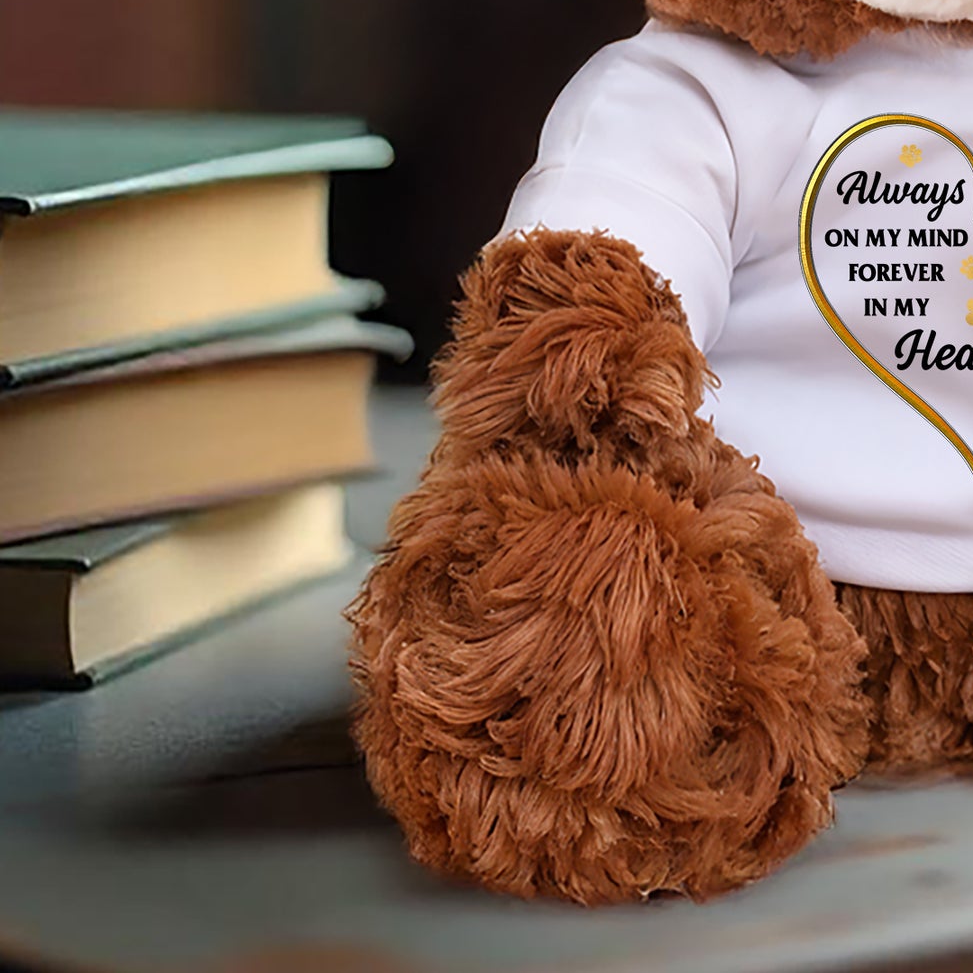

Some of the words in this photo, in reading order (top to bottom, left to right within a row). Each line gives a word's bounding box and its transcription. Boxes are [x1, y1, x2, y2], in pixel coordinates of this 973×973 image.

[837, 171, 965, 222] Always
[825, 229, 858, 247] ON
[866, 229, 901, 246] MY
[908, 229, 968, 247] MIND
[849, 264, 945, 281] FOREVER
[864, 299, 887, 316] IN
[894, 298, 929, 316] MY
